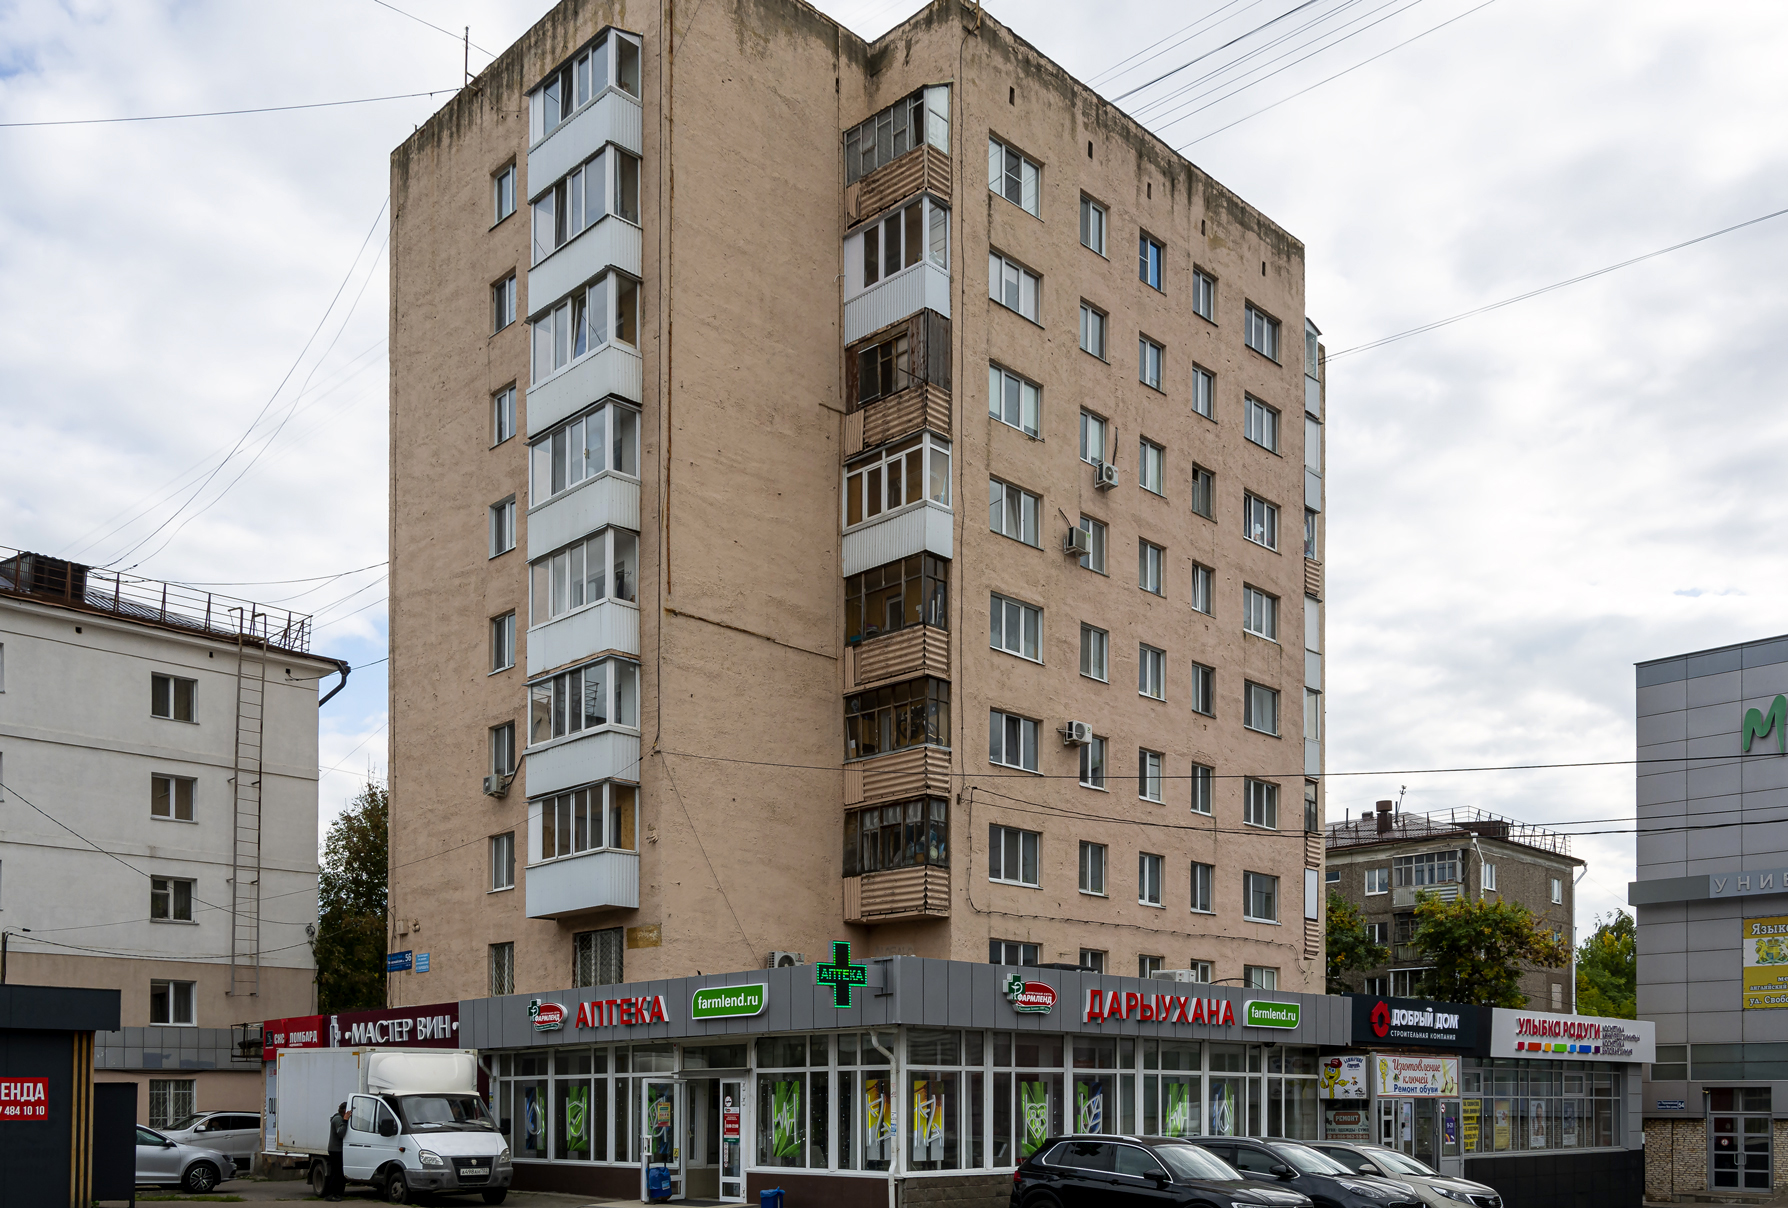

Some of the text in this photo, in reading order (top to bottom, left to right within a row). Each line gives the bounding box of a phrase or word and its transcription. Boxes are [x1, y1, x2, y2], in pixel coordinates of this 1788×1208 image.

[405, 953, 411, 962] 56
[820, 968, 863, 981] АПТЕКА
[1750, 983, 1787, 991] английский
[698, 992, 759, 1010] farmlend.ru
[1017, 994, 1052, 1005] ФАРМЛЕНД
[1749, 998, 1762, 1006] ул.
[575, 995, 668, 1028] АПТЕКА
[1085, 989, 1236, 1026] ДАРЫУХАНА
[1251, 1005, 1296, 1022] farmlend.ru
[1391, 1007, 1459, 1029] ДОБРЫЙ ДОМ
[352, 1015, 451, 1044] МАСТЕР ВИН
[1390, 1030, 1456, 1040] СТРОИТЕЛЬНАЯ КОМПАНИЯ
[289, 1030, 318, 1043] ЛОМБАРД
[1392, 1059, 1441, 1075] Изготовление
[1403, 1074, 1428, 1084] ключей
[1394, 1084, 1438, 1095] Ремонт обуви
[4, 1105, 20, 1116] 484
[23, 1105, 33, 1116] 10
[35, 1105, 45, 1116] 10
